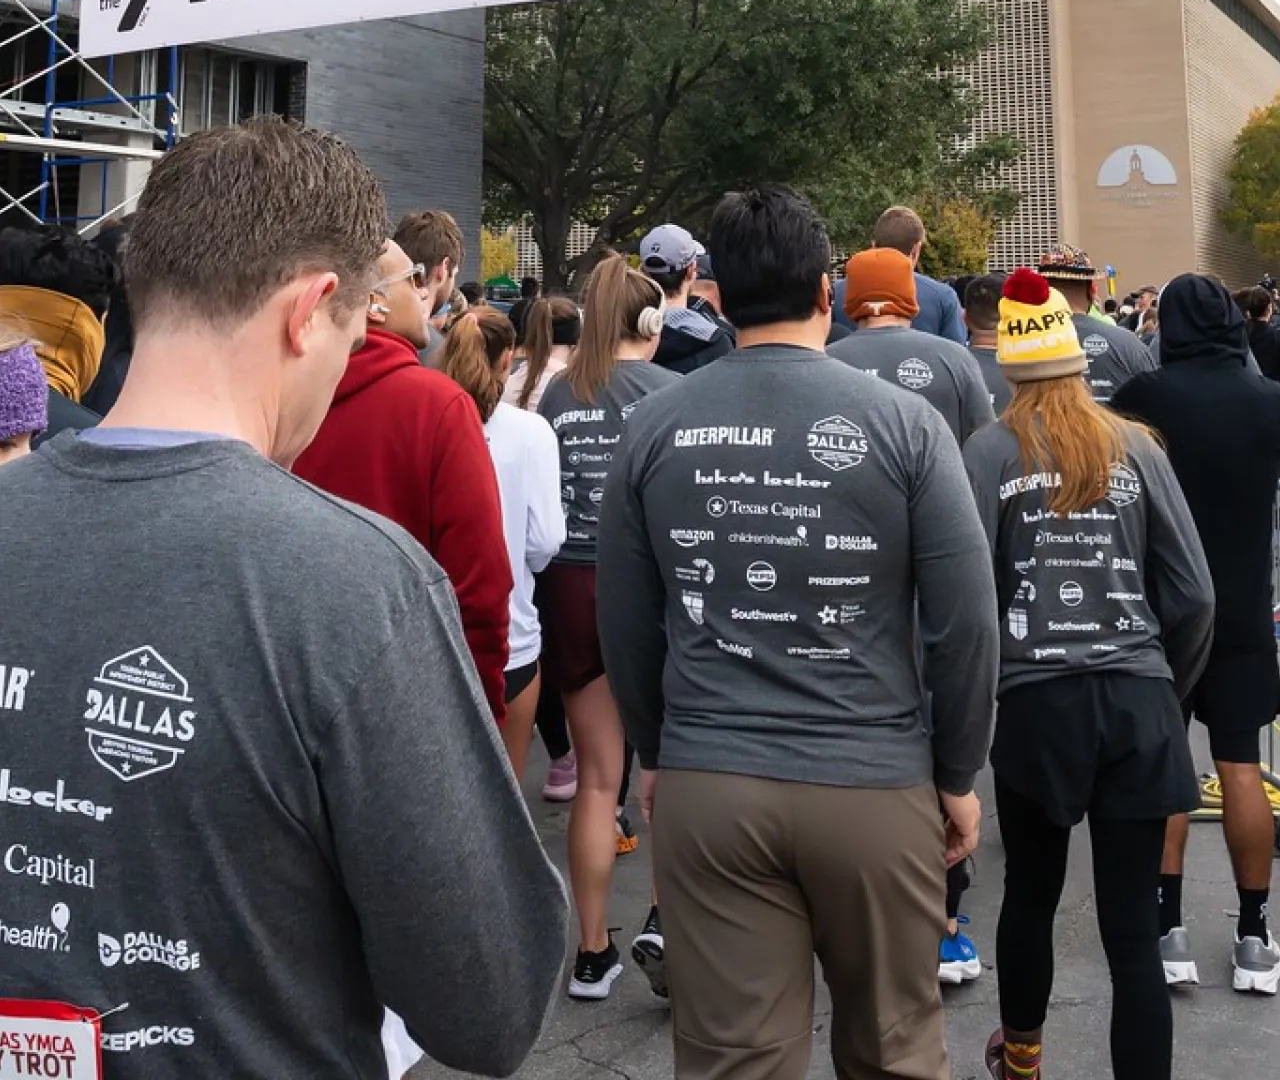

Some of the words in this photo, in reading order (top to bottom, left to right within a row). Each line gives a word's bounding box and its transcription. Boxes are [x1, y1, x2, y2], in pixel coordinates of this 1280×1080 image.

[675, 427, 772, 447] CATERPILLAR
[807, 434, 867, 452] DALLAS
[1000, 472, 1062, 500] CATERPILLA
[730, 500, 768, 515] Texas
[771, 502, 821, 520] Capital
[670, 528, 715, 542] amazon
[1045, 532, 1073, 543] Texas
[1075, 531, 1111, 546] Capital
[83, 688, 195, 741] DALLAS
[5, 844, 95, 888] Capital
[124, 932, 187, 956] DALLAS
[124, 947, 200, 971] COLLEGE
[23, 1033, 75, 1054] YMCA
[11, 1052, 76, 1078] TROT
